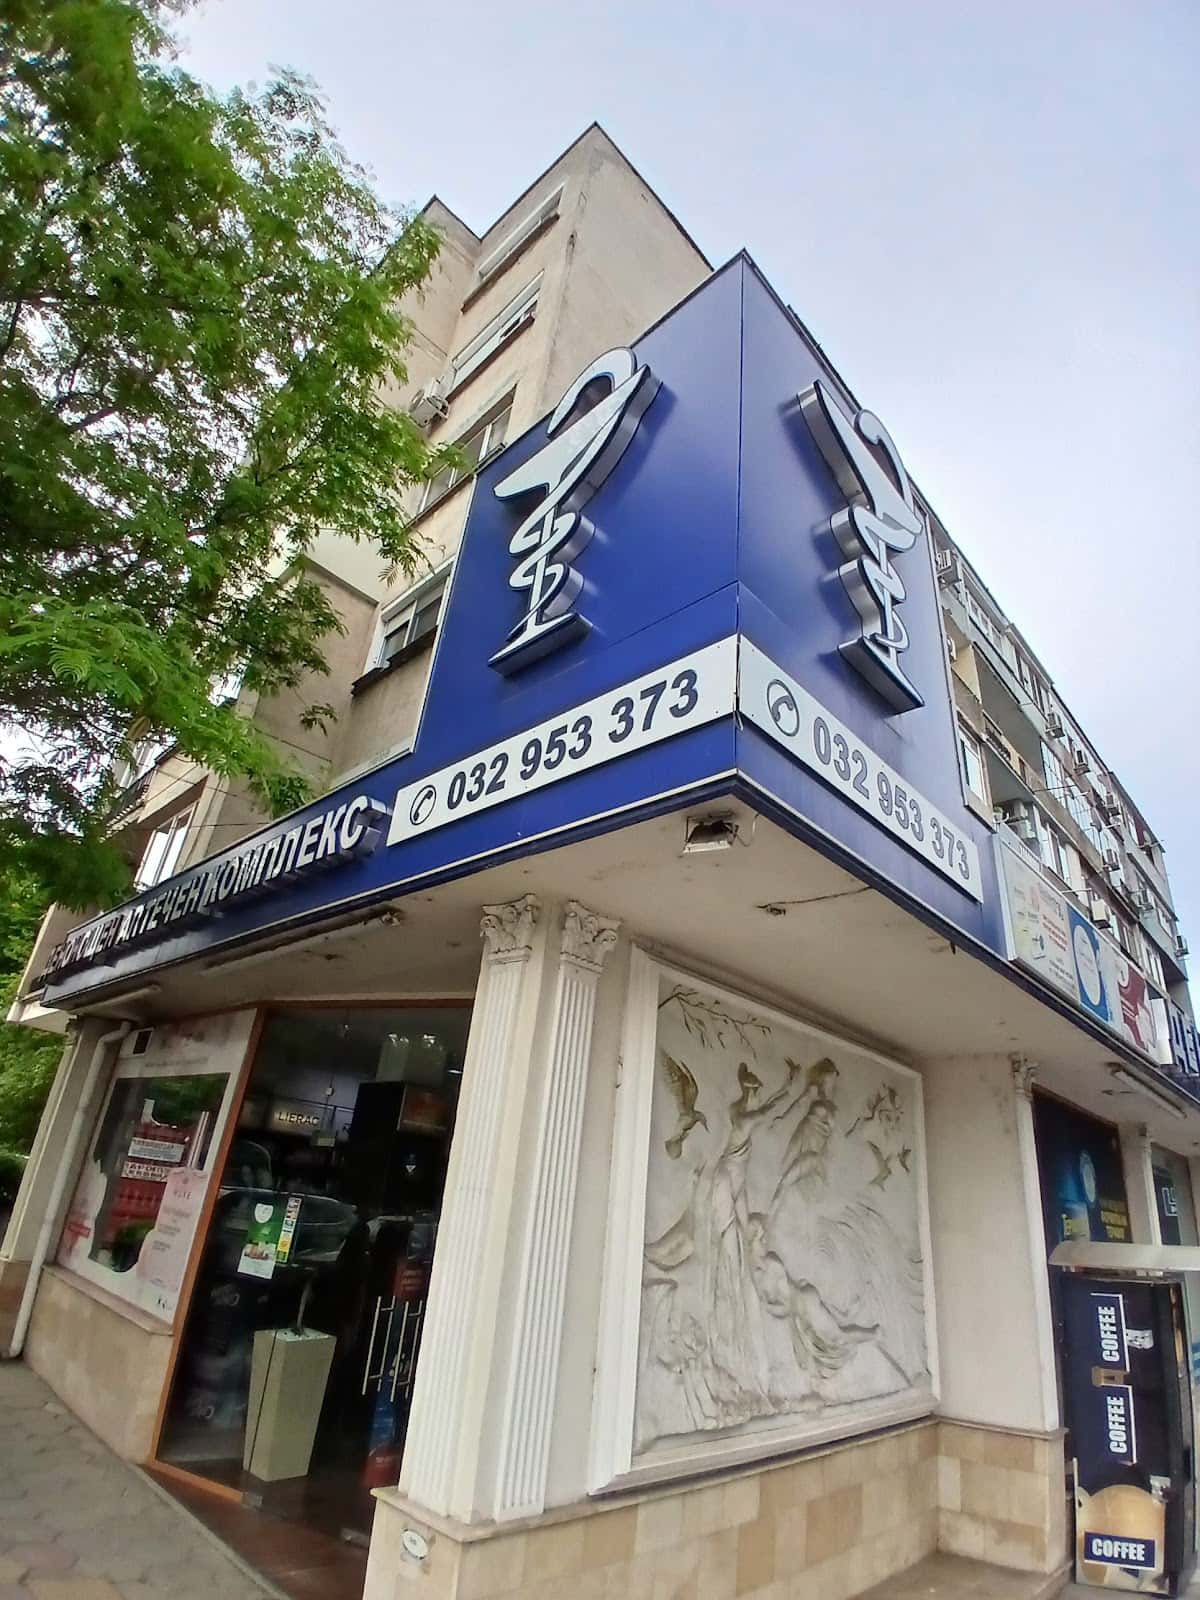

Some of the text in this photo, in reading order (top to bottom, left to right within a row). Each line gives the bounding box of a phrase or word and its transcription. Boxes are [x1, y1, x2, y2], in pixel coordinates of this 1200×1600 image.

[446, 668, 698, 810] 032 953 373
[813, 716, 970, 881] 032 953 373
[115, 872, 204, 945] АПТЕЧЕН
[203, 795, 370, 907] КОМПЛЕКС
[1098, 1306, 1120, 1362] COFFEE
[1106, 1396, 1128, 1454] COFFEE
[1091, 1537, 1145, 1562] COFFEE
